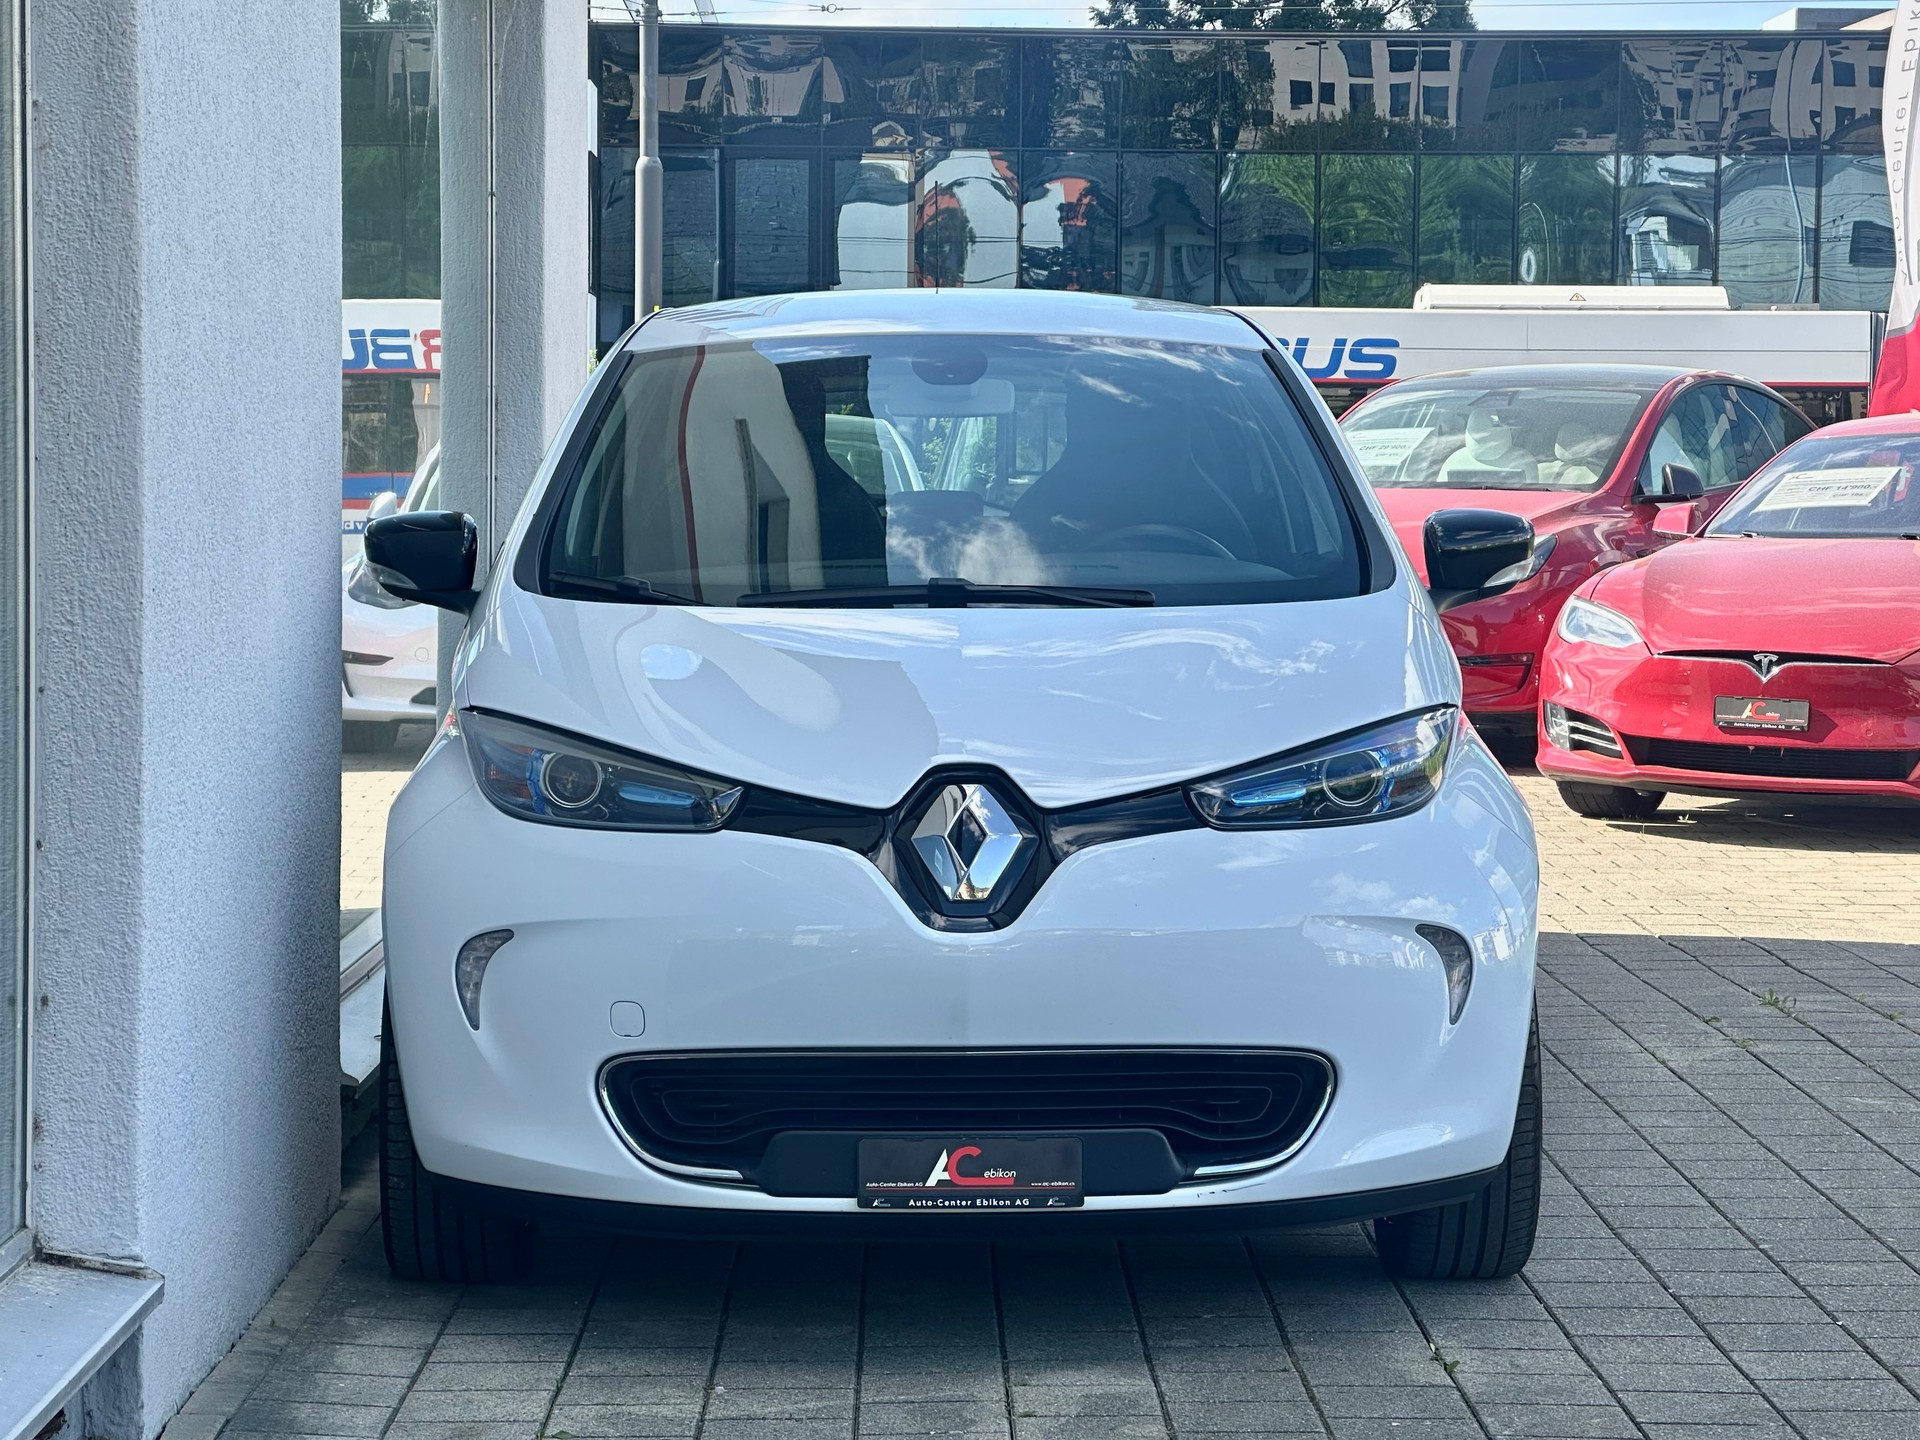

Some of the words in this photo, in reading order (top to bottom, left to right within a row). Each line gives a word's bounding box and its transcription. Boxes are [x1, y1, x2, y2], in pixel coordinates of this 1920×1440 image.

[1276, 337, 1400, 379] US
[1741, 701, 1779, 720] AC
[925, 1145, 1014, 1187] AC
[983, 1168, 1017, 1179] ebikon
[908, 1199, 972, 1207] Auto-Center
[976, 1198, 1011, 1206] Ebikon
[1015, 1198, 1030, 1206] AG
